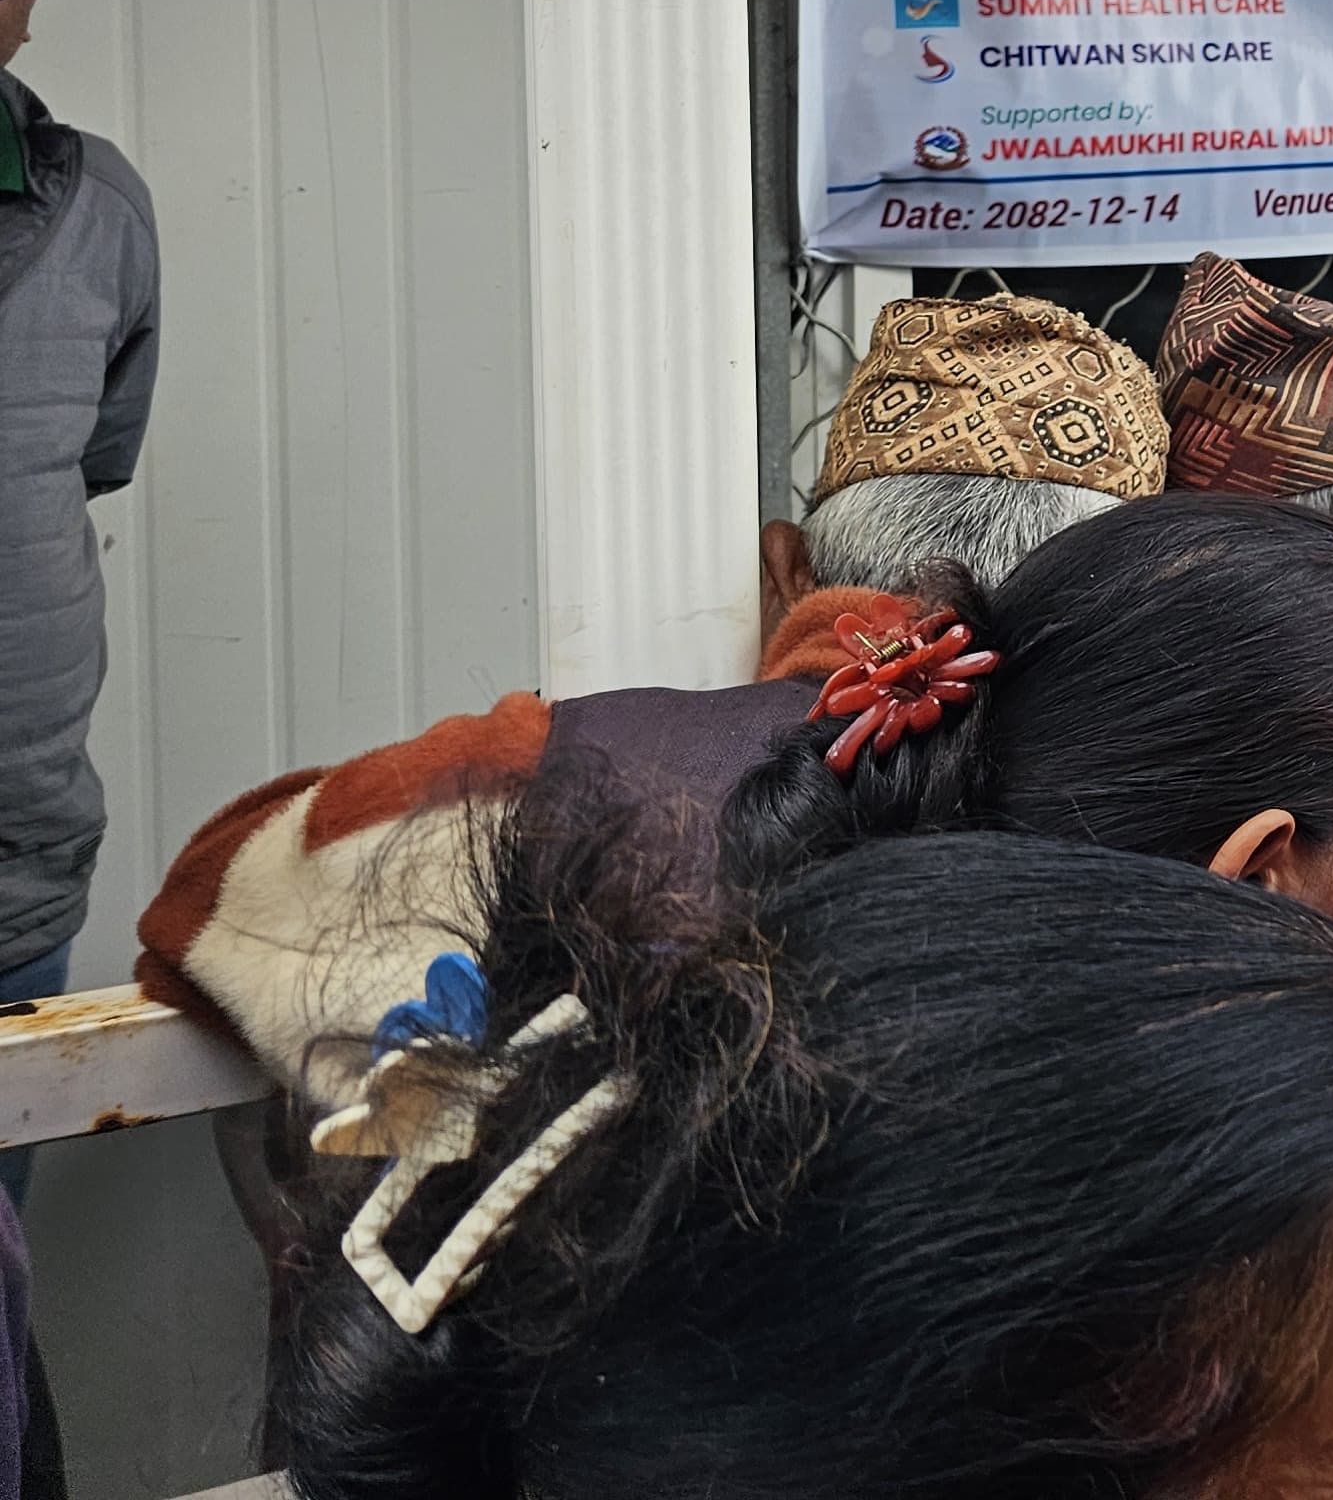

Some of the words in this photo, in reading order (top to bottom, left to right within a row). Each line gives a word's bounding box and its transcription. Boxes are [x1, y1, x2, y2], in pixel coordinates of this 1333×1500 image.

[980, 44, 1124, 67] CHITWAN
[1132, 43, 1195, 64] SKIN
[1202, 41, 1273, 62] CARE
[981, 102, 1113, 130] Supported
[1118, 101, 1153, 125] by:
[981, 132, 1184, 161] JWALAMUKHI
[1191, 128, 1279, 152] RURAL
[880, 199, 975, 230] Date:
[983, 193, 1182, 229] 2082-12-14
